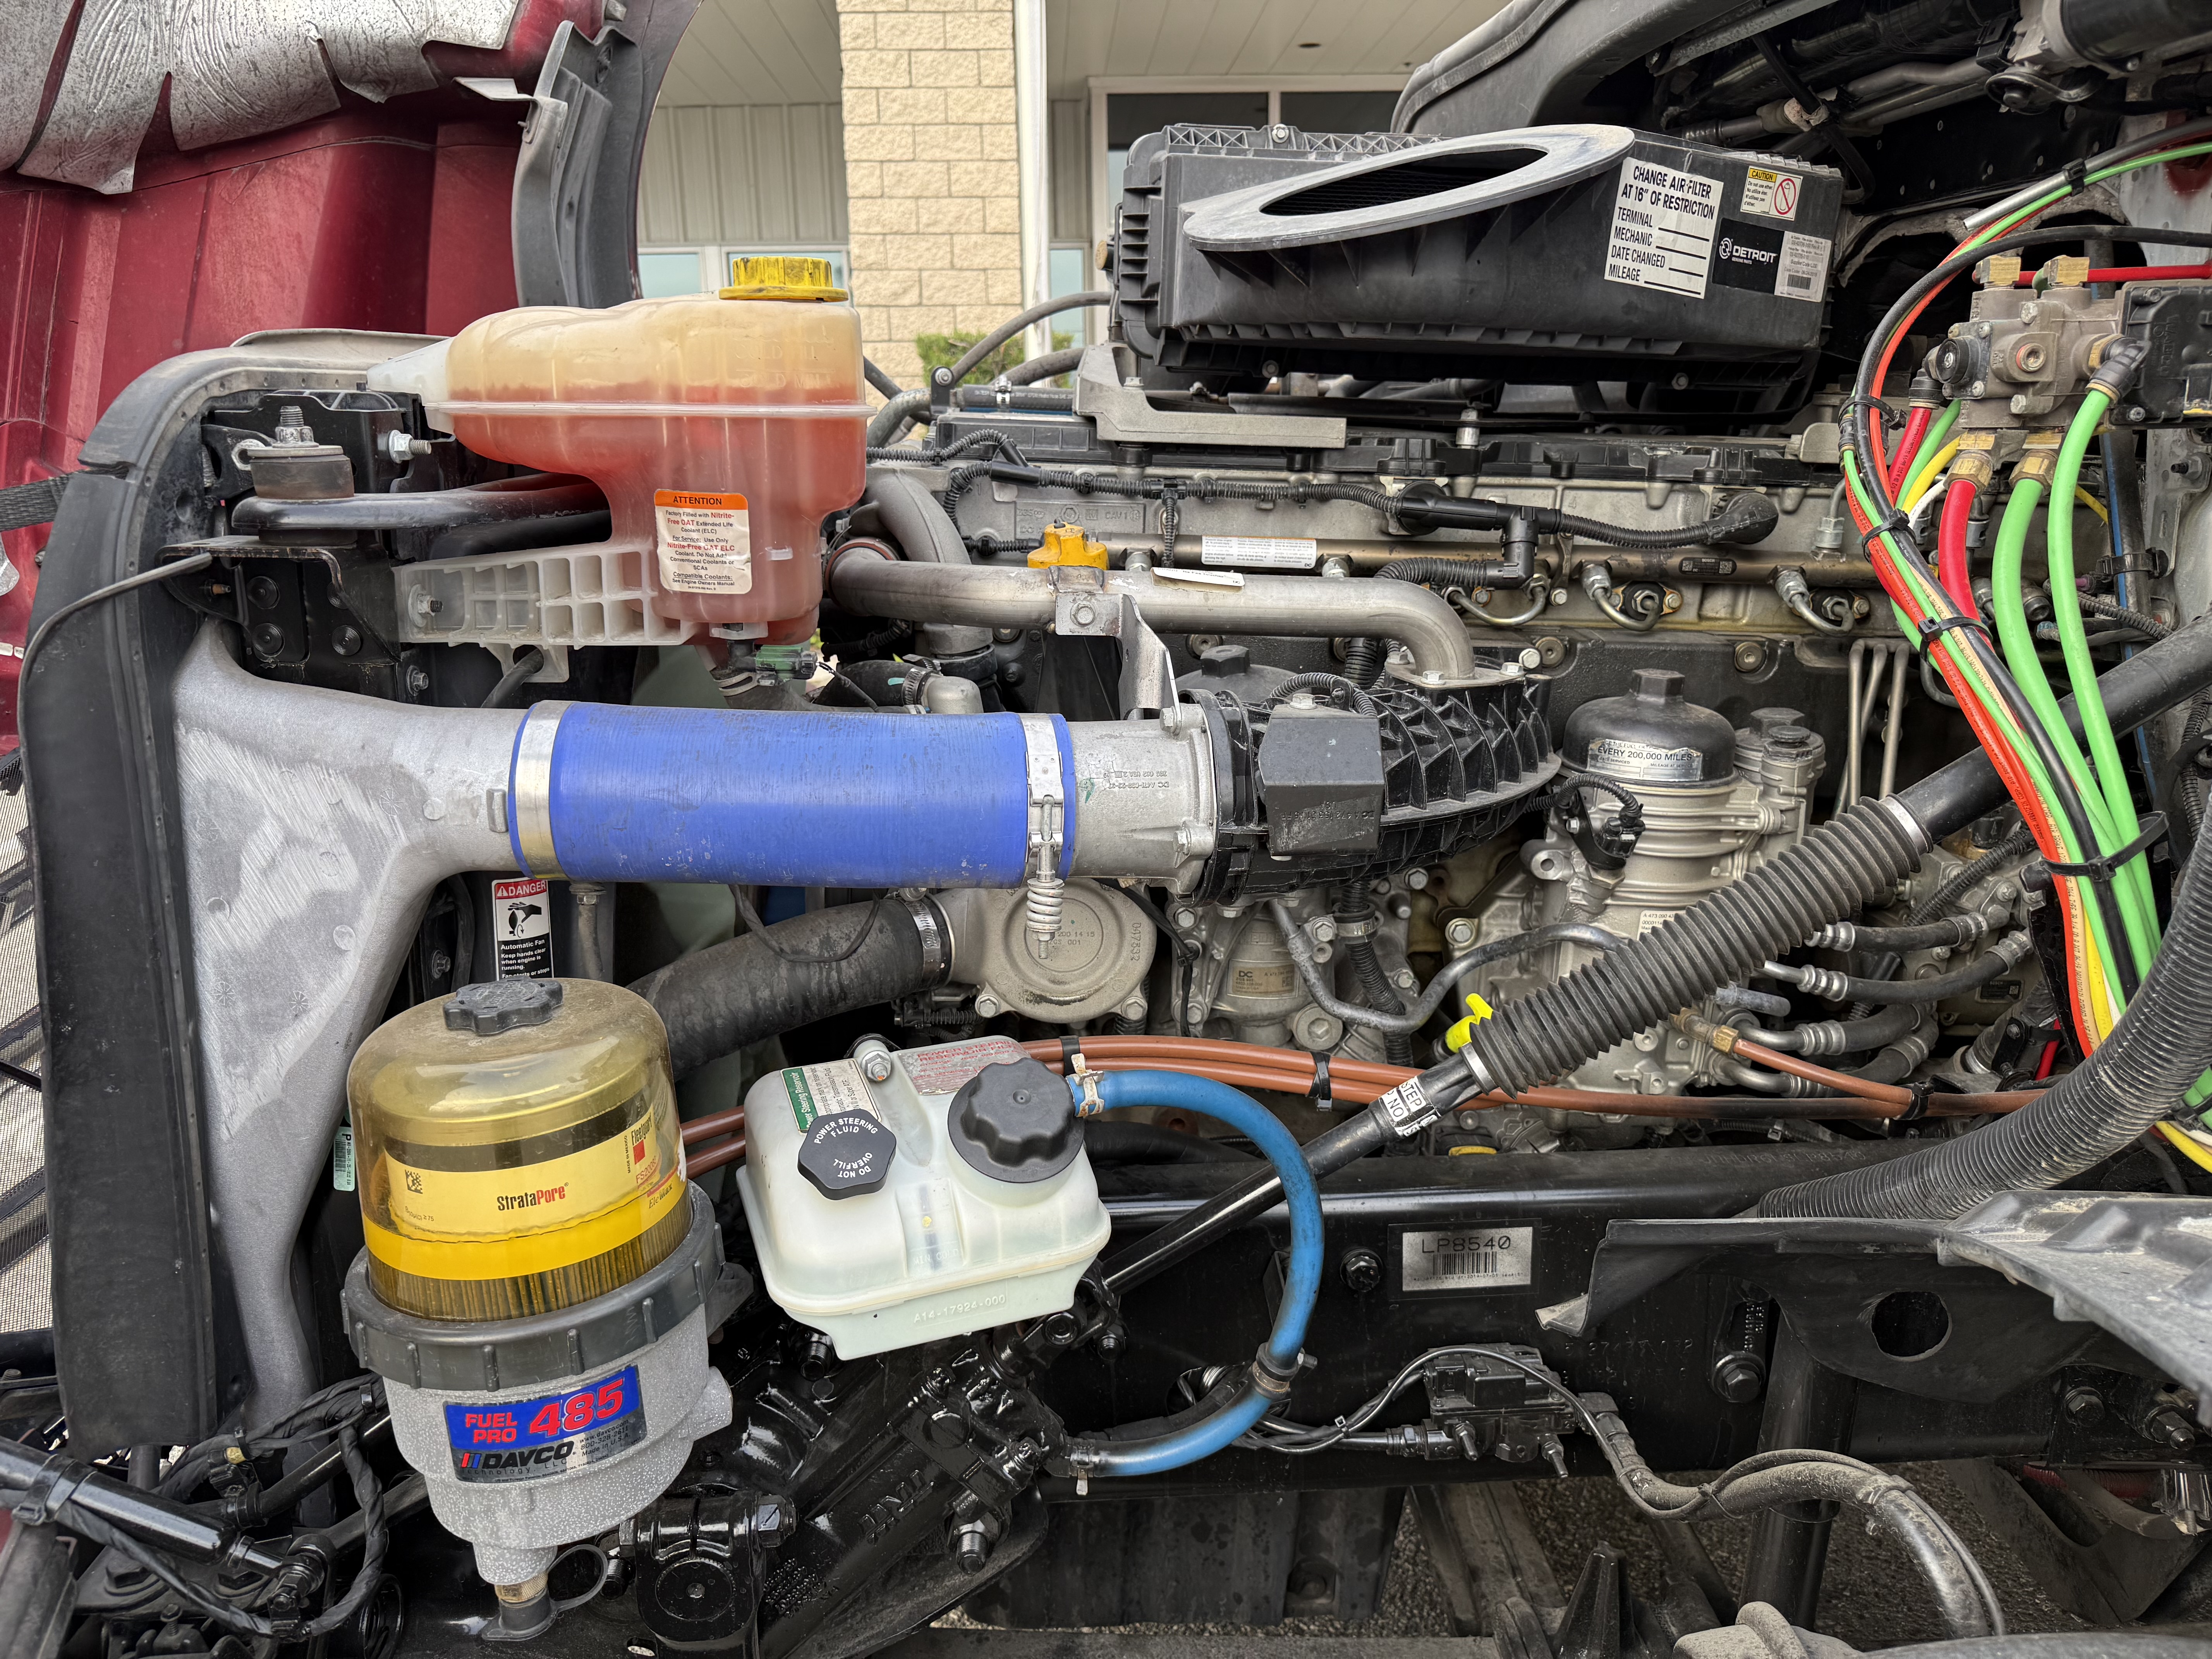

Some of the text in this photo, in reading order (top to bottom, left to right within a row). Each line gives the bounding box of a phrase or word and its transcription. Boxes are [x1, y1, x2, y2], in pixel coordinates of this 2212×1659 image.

[1633, 166, 1711, 199] CHANGE AIR FILTER
[1752, 170, 1773, 180] CAUTION
[1621, 183, 1633, 198] AT
[1650, 191, 1661, 206] OF
[1662, 194, 1714, 220] RESTRICTION
[1618, 207, 1653, 227] TERMINAL
[1614, 227, 1652, 246] MECHANIC
[1611, 245, 1665, 268] DATE CHANGED
[1733, 246, 1776, 263] DETROIT
[1609, 264, 1640, 282] MILEAGE
[673, 496, 722, 505] ATTENTION
[1598, 746, 1692, 761] EVERY 200,000 MILES
[508, 881, 546, 896] DANGER
[1130, 921, 1141, 961] 047532
[917, 1048, 962, 1058] POWER
[920, 1048, 987, 1061] RESERVOIR
[790, 1072, 804, 1093] Reservoir
[817, 1087, 825, 1097] mark
[823, 1068, 841, 1098] Transmission Fluid
[799, 1093, 810, 1113] Steering
[1401, 1082, 1422, 1106] STEP
[1388, 1098, 1404, 1117] NO
[814, 1118, 878, 1144] POWER STEERING
[831, 1126, 859, 1137] FLUID
[833, 1152, 872, 1169] OVERFILL
[859, 1165, 871, 1175] DO
[1422, 1235, 1511, 1253] LP8540
[914, 1254, 931, 1265] MIN
[914, 1294, 1006, 1324] A14-17924-000
[465, 1377, 625, 1438] FUEL 485
[473, 1429, 517, 1443] PRO
[580, 1420, 629, 1443] www.davco.com
[581, 1425, 628, 1450] 800-328-2611
[582, 1447, 599, 1456] Made
[611, 1433, 630, 1445] U.S.A.
[482, 1440, 575, 1469] DAVCO
